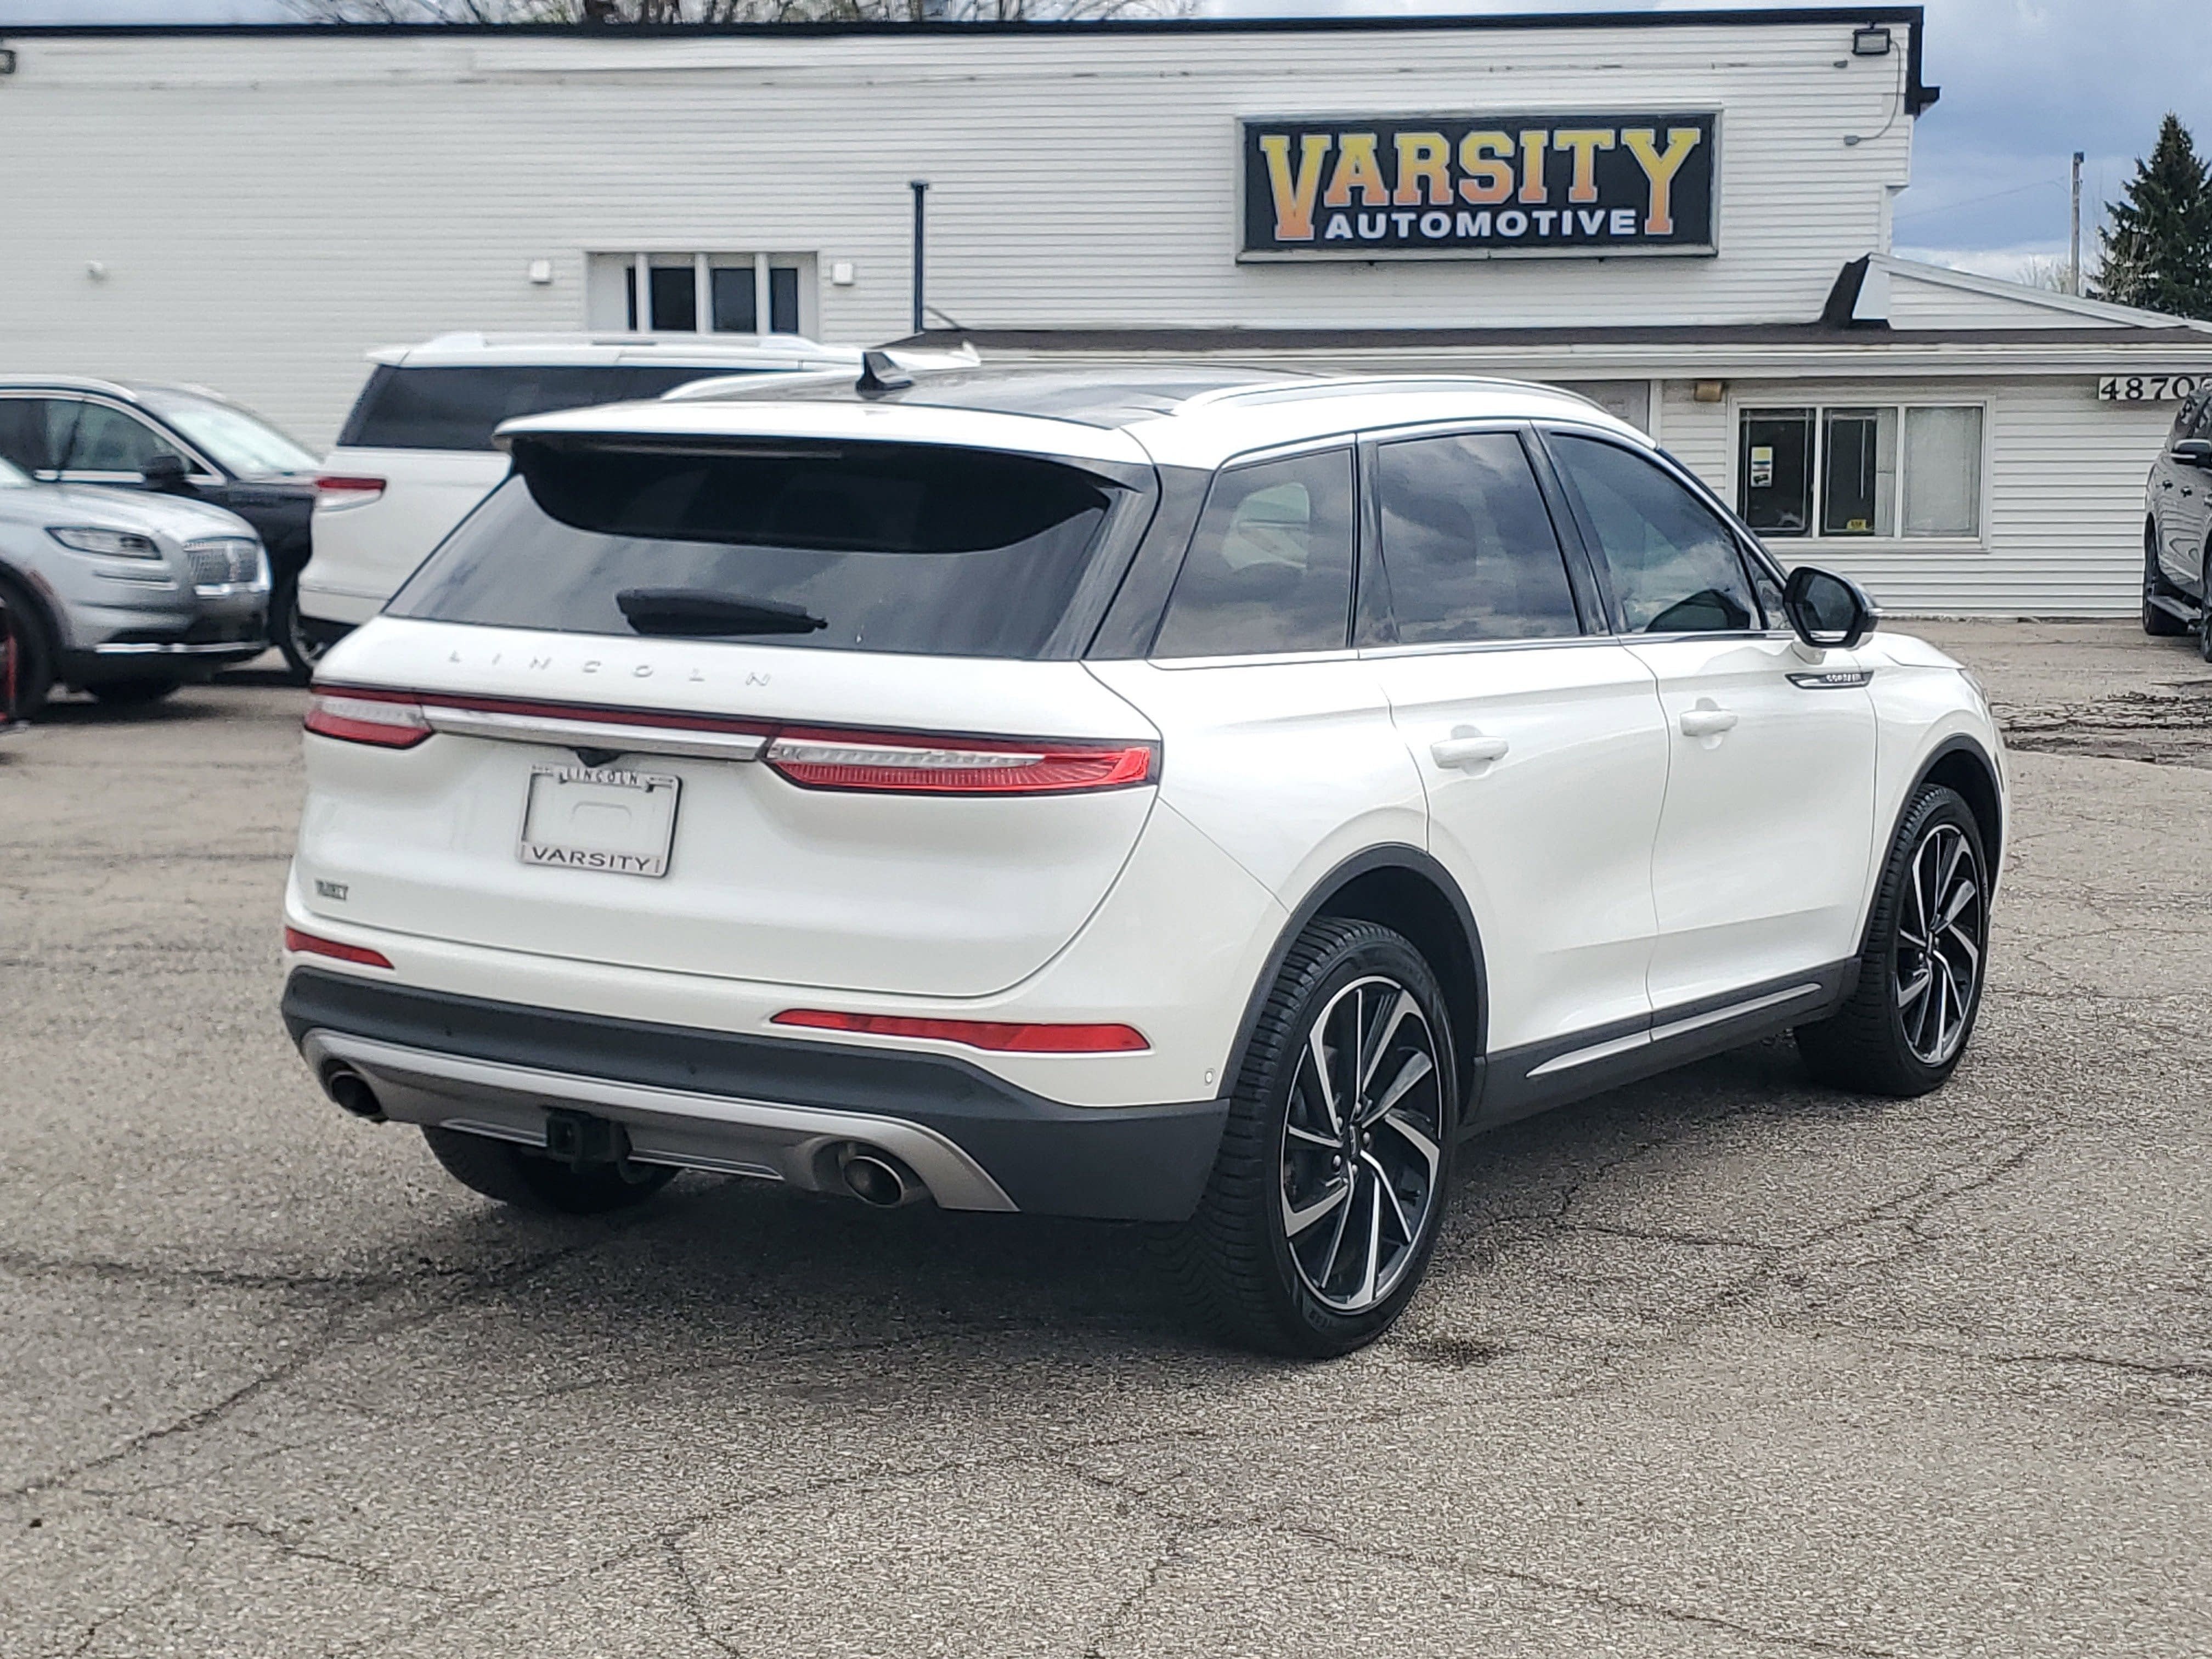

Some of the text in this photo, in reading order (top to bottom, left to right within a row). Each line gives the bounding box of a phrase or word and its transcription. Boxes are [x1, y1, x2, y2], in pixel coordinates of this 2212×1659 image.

[1260, 128, 1700, 240] VARSITY
[1324, 210, 1637, 239] AUTOMOTIVE
[449, 650, 770, 686] LINCOLN
[566, 767, 638, 785] LINCOLN
[533, 847, 650, 871] VARSITY
